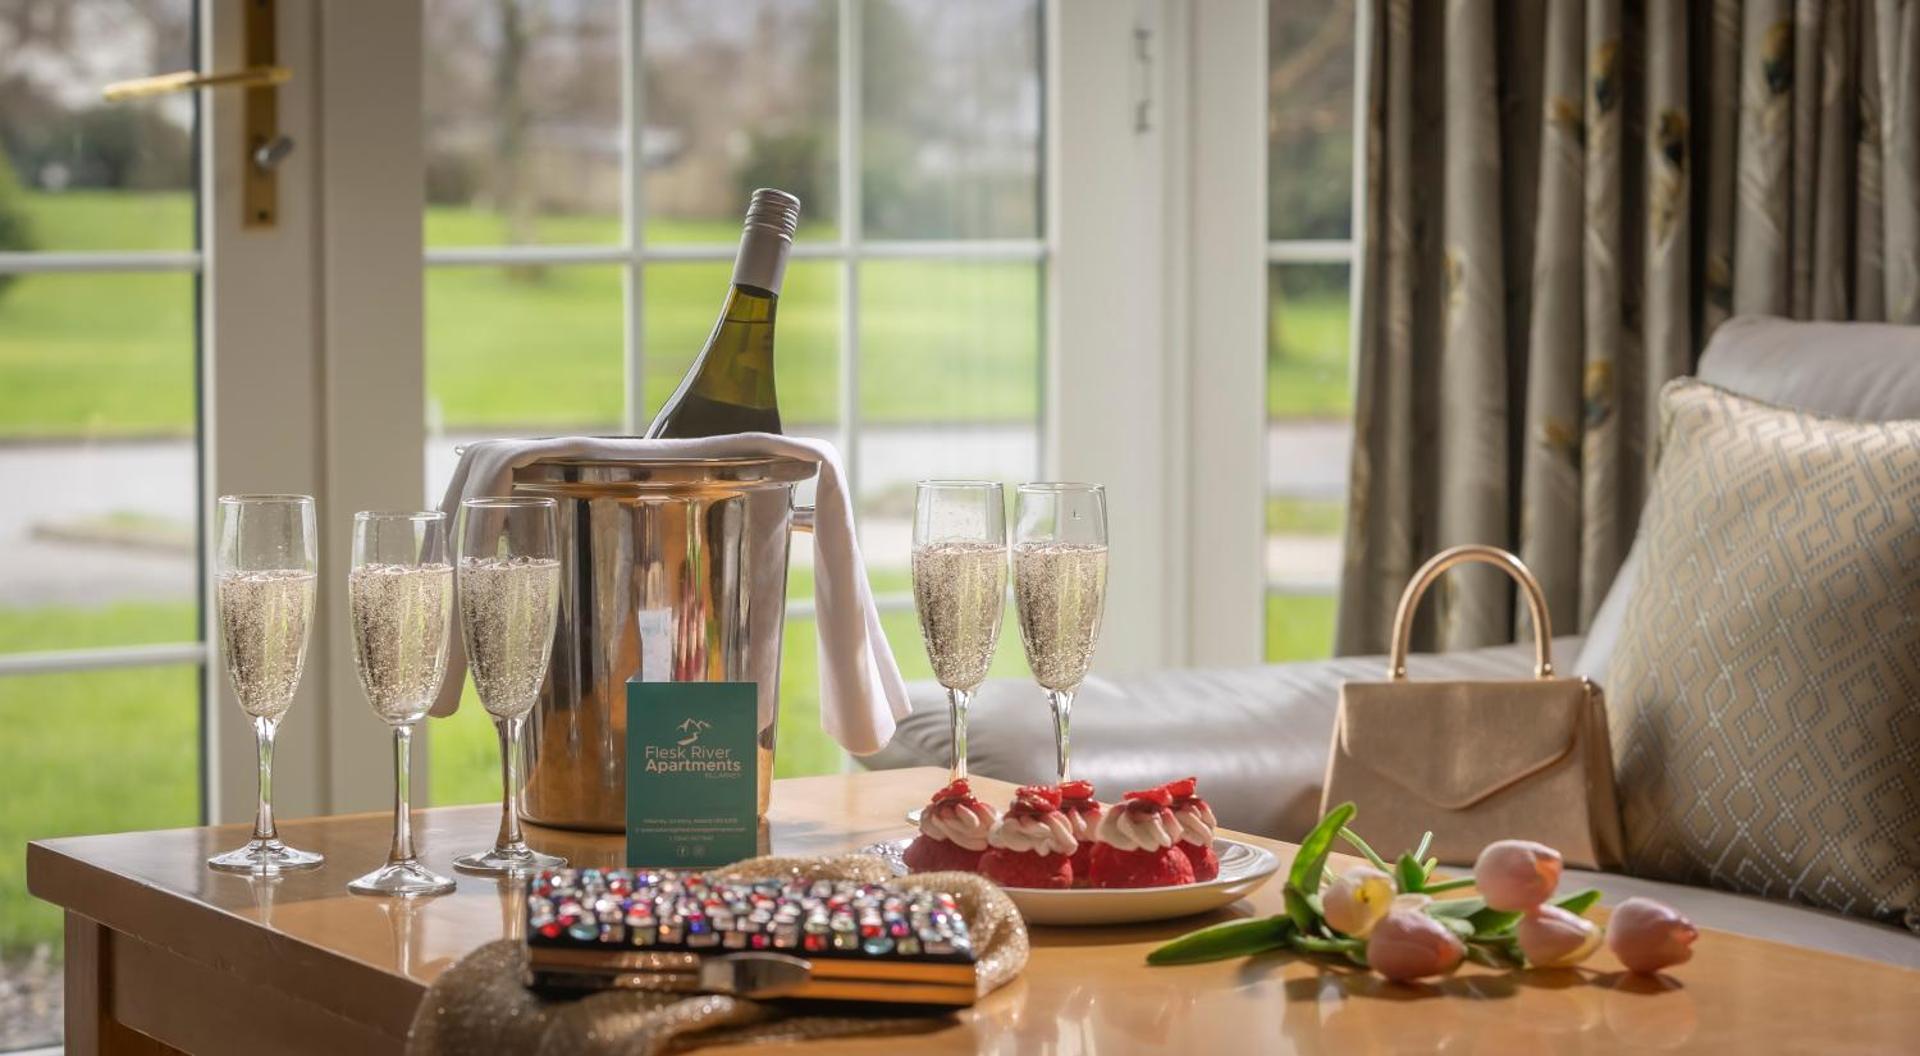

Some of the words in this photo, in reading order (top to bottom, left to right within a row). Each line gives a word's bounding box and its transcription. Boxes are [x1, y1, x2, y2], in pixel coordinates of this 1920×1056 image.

[645, 746, 686, 759] Flesk
[691, 746, 731, 759] River
[645, 759, 741, 773] Apartments
